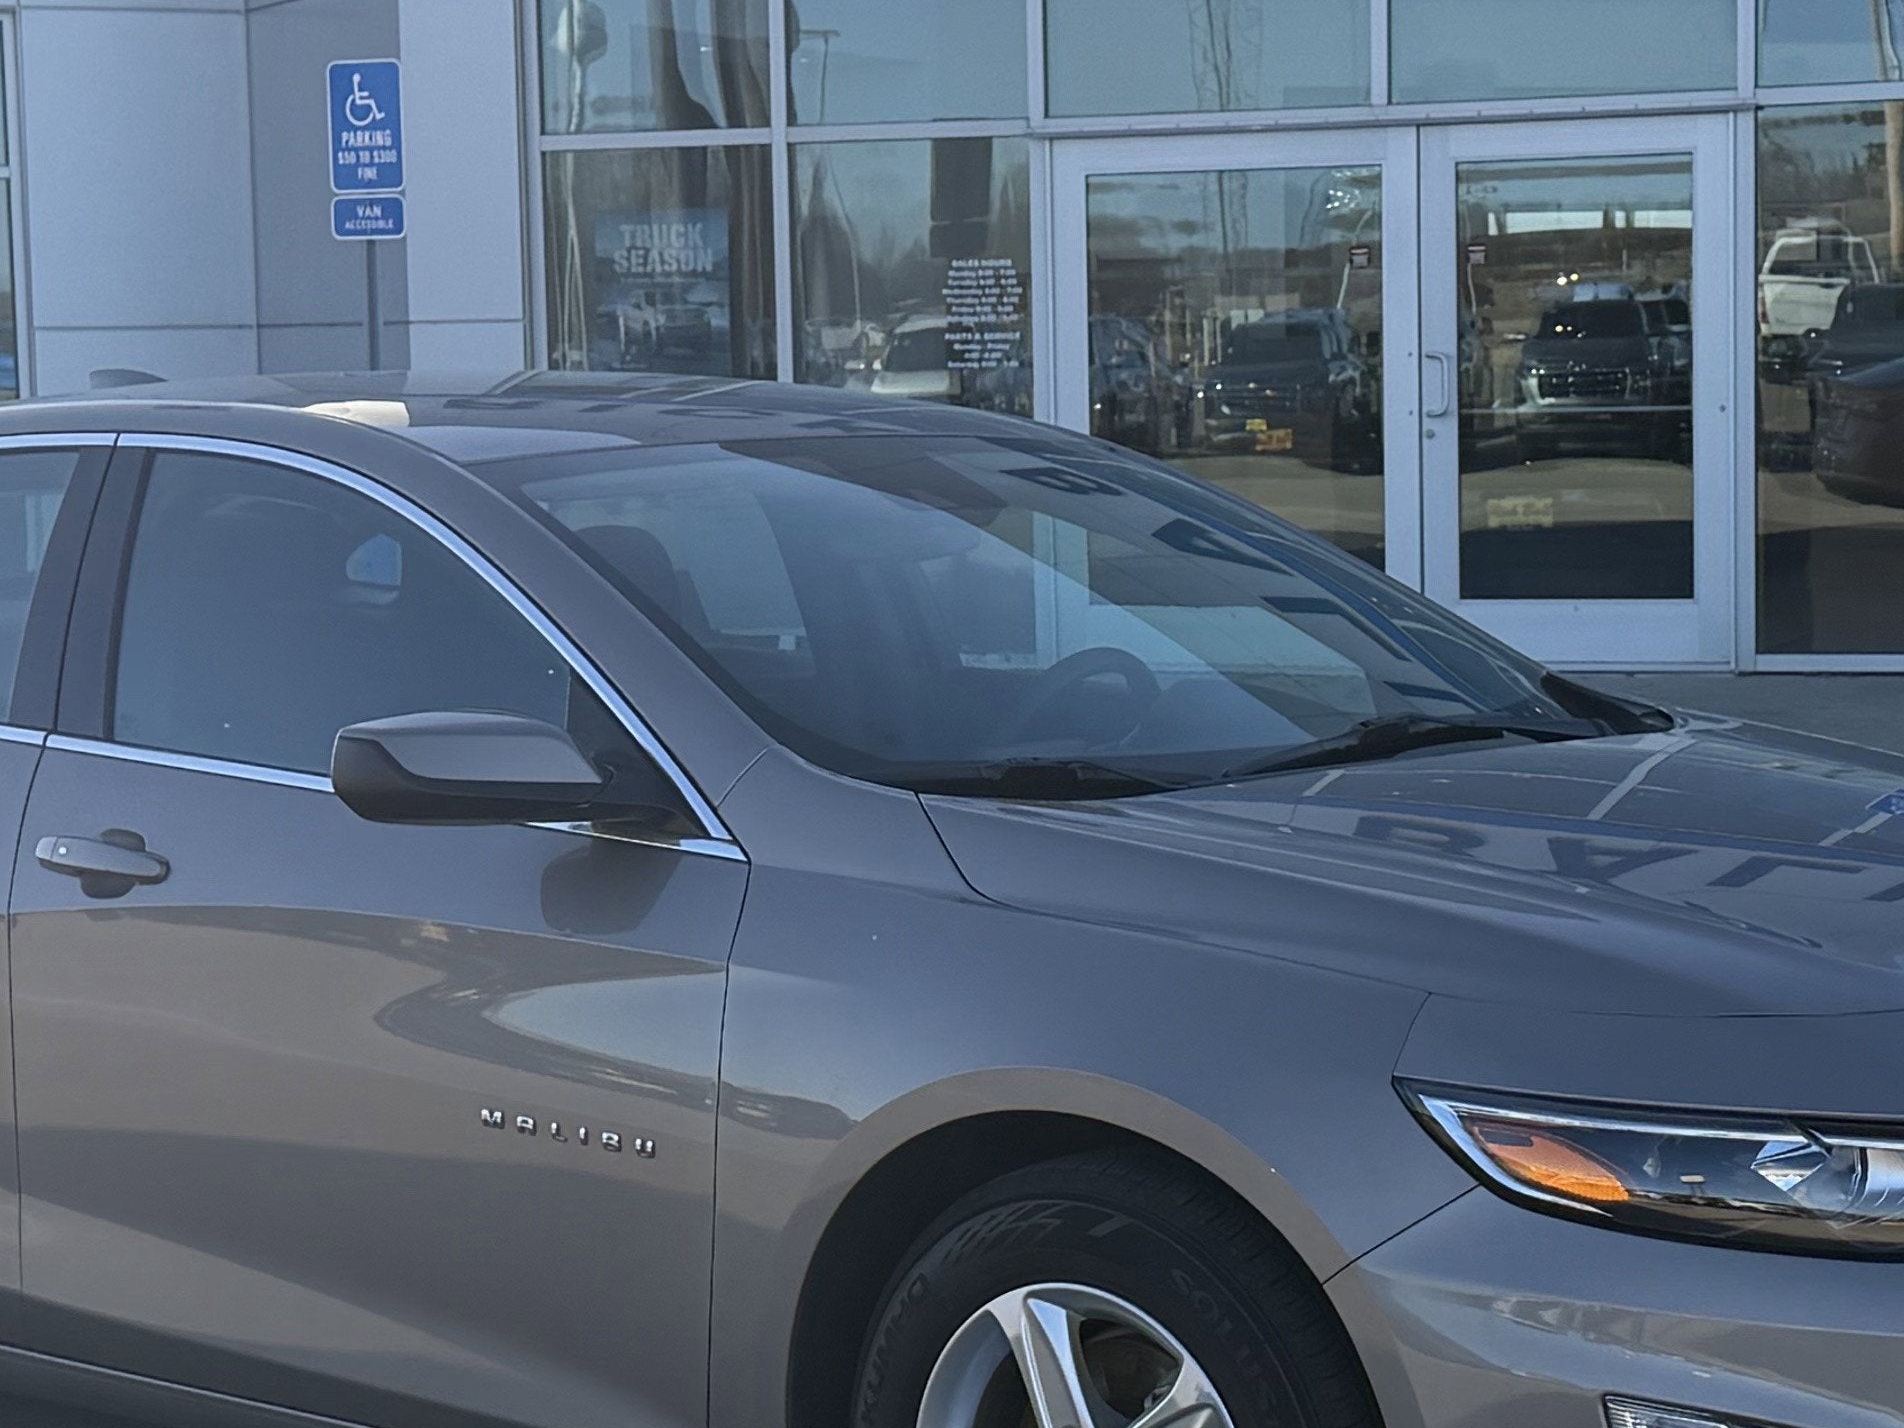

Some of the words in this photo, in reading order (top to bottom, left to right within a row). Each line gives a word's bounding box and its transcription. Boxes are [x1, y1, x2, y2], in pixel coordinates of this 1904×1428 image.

[342, 130, 392, 148] PARKING
[357, 167, 378, 180] FINE
[356, 205, 382, 218] VAN
[619, 223, 704, 248] TRUCK
[613, 249, 713, 273] SEASON
[481, 1109, 656, 1158] MALIBU
